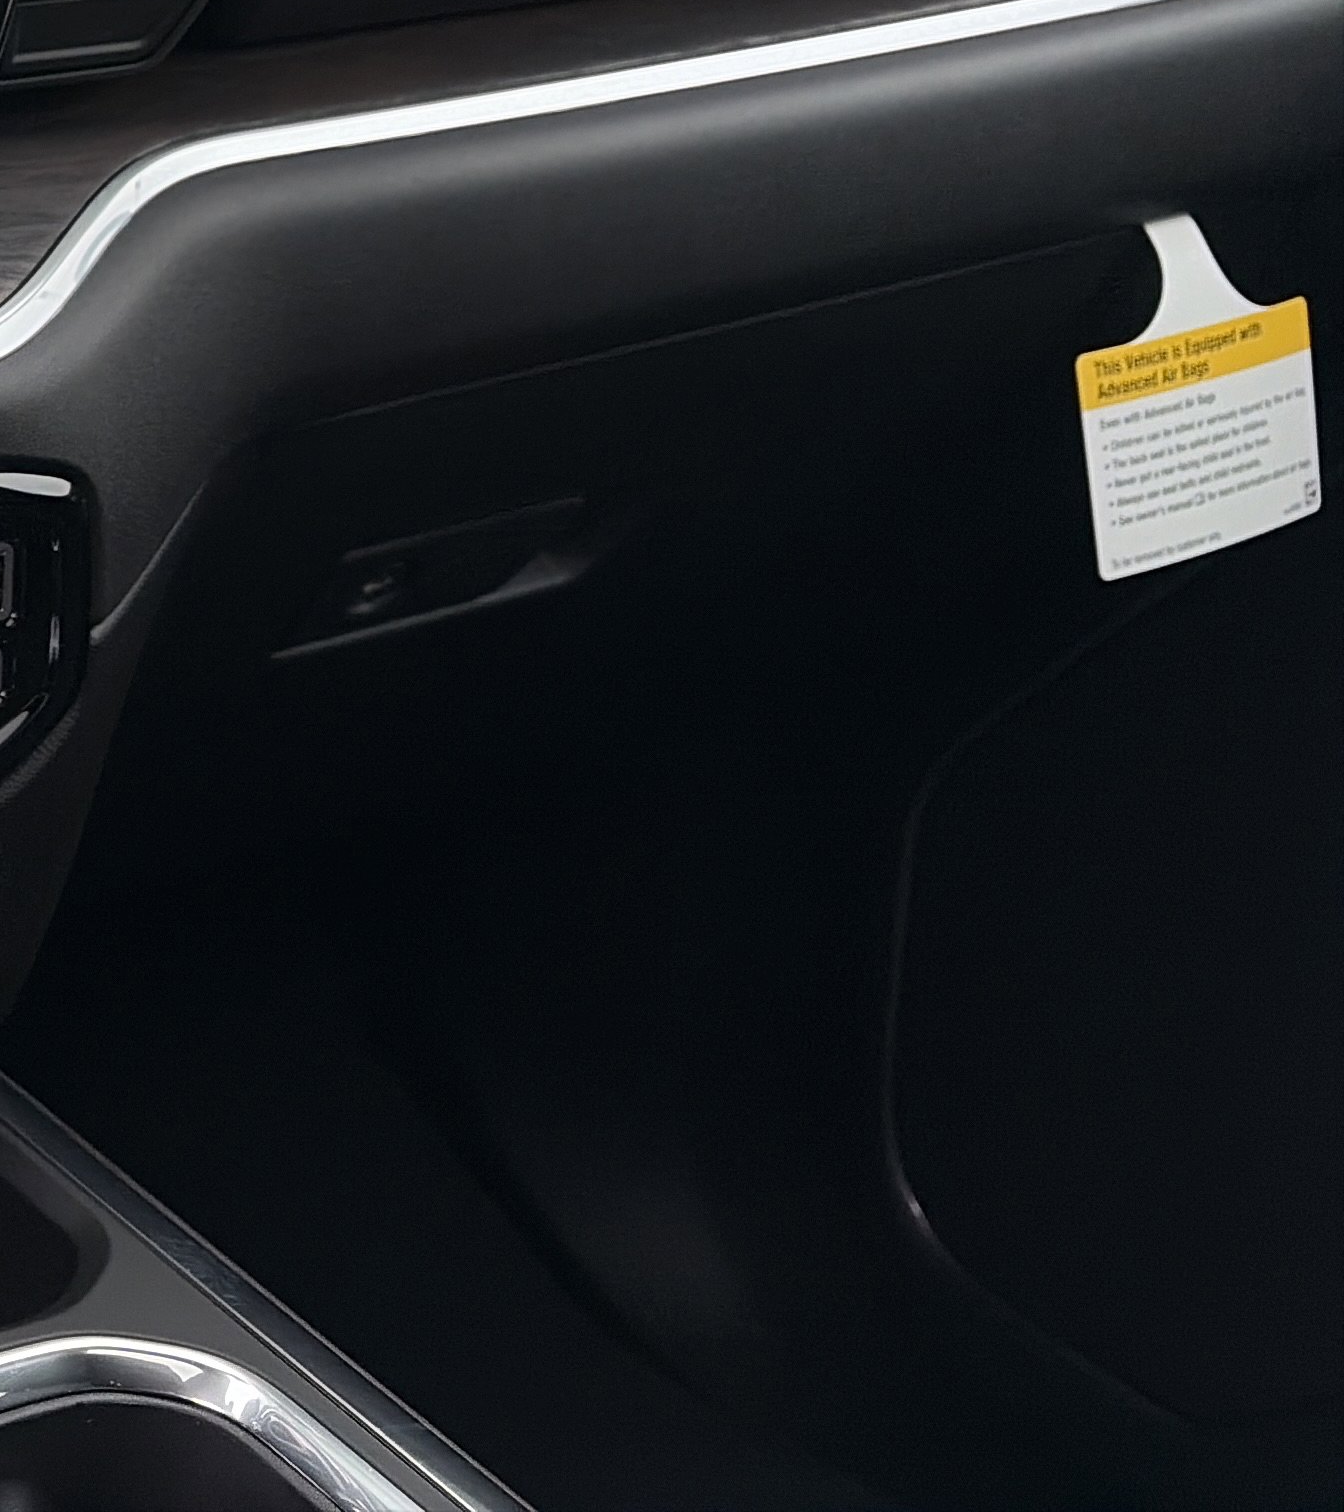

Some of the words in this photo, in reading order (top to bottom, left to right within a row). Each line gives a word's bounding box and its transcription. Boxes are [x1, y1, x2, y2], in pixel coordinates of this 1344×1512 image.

[1094, 359, 1123, 378] This
[1124, 347, 1169, 370] Vehicle
[1171, 344, 1183, 359] is
[1184, 327, 1237, 356] Equipped
[1238, 321, 1262, 340] with
[1097, 370, 1159, 399] Advanced
[1161, 365, 1178, 384] Air
[1180, 358, 1211, 380] Bags
